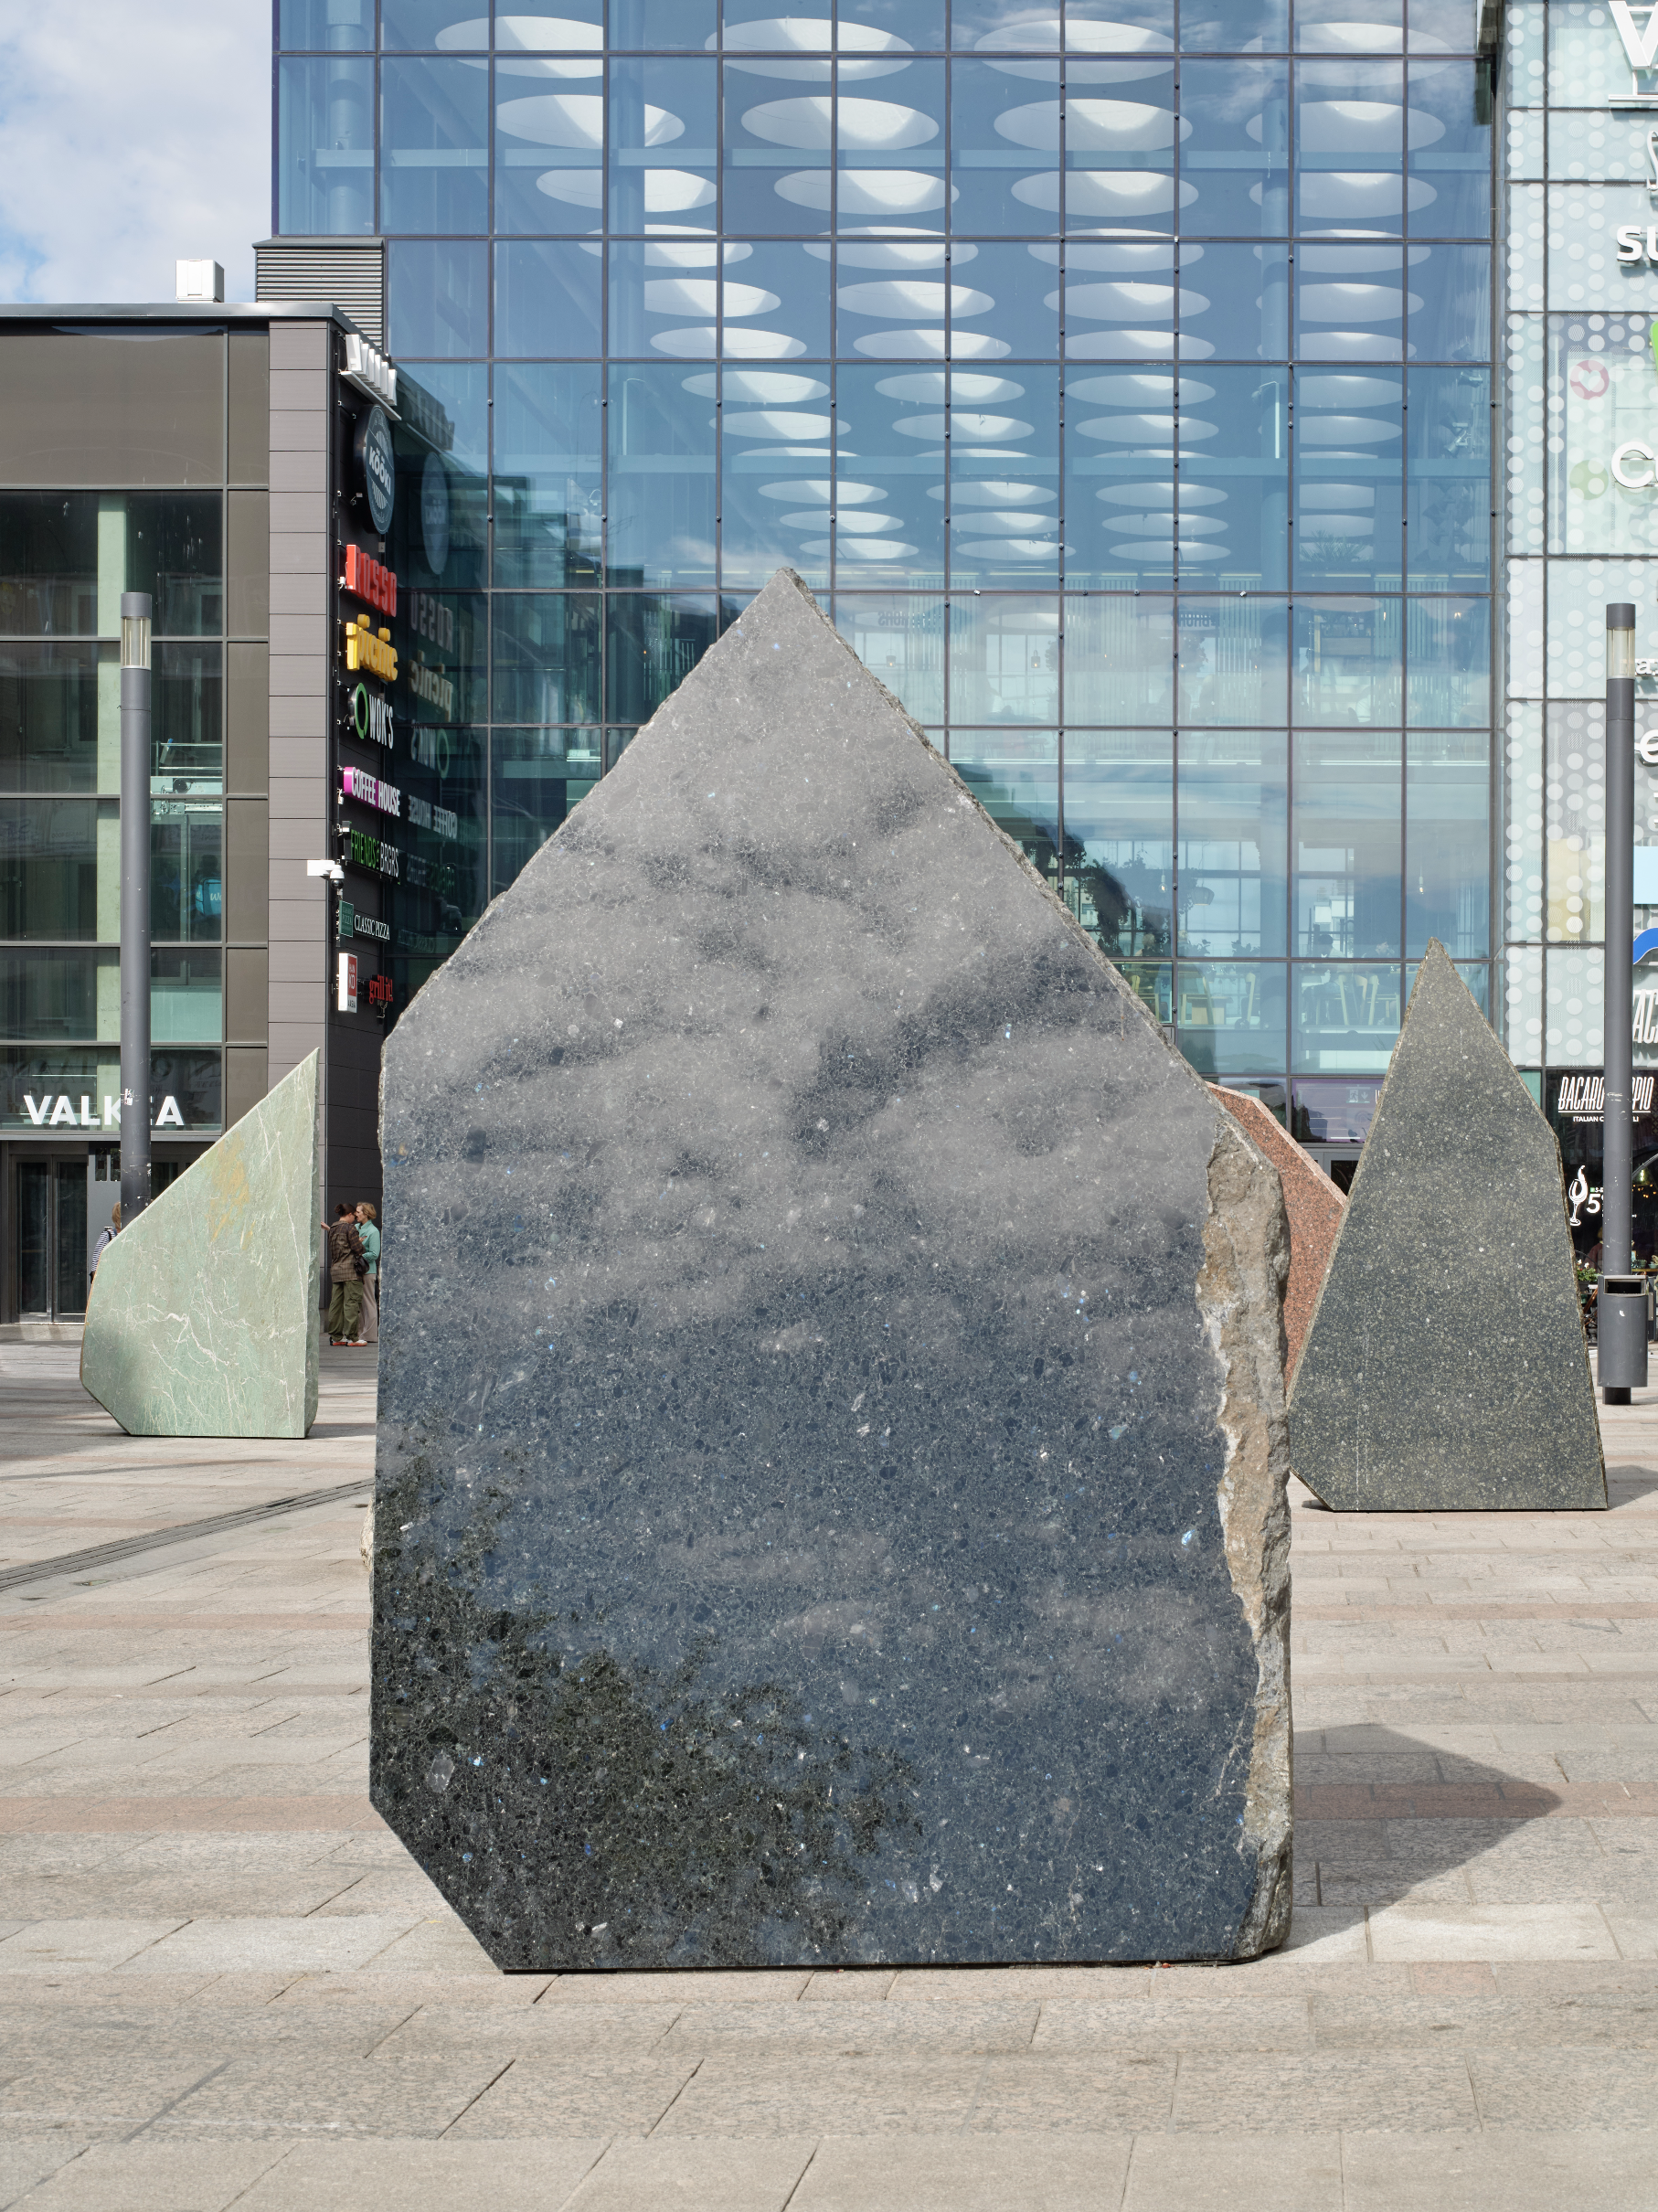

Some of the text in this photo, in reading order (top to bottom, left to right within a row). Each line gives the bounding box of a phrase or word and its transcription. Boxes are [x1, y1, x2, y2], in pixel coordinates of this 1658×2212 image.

[369, 445, 392, 495] KÖÖKI
[346, 544, 397, 618] ROSSO
[346, 613, 399, 682] picnic
[369, 694, 394, 750] WOK'S
[352, 766, 400, 817] COFFEE HOUSE
[351, 829, 376, 868] FRIENDS
[380, 842, 399, 878] BRGRS
[355, 914, 390, 941] CLASSIC PIZZA
[369, 974, 394, 1005] grill it!
[24, 1094, 185, 1126] VALKA
